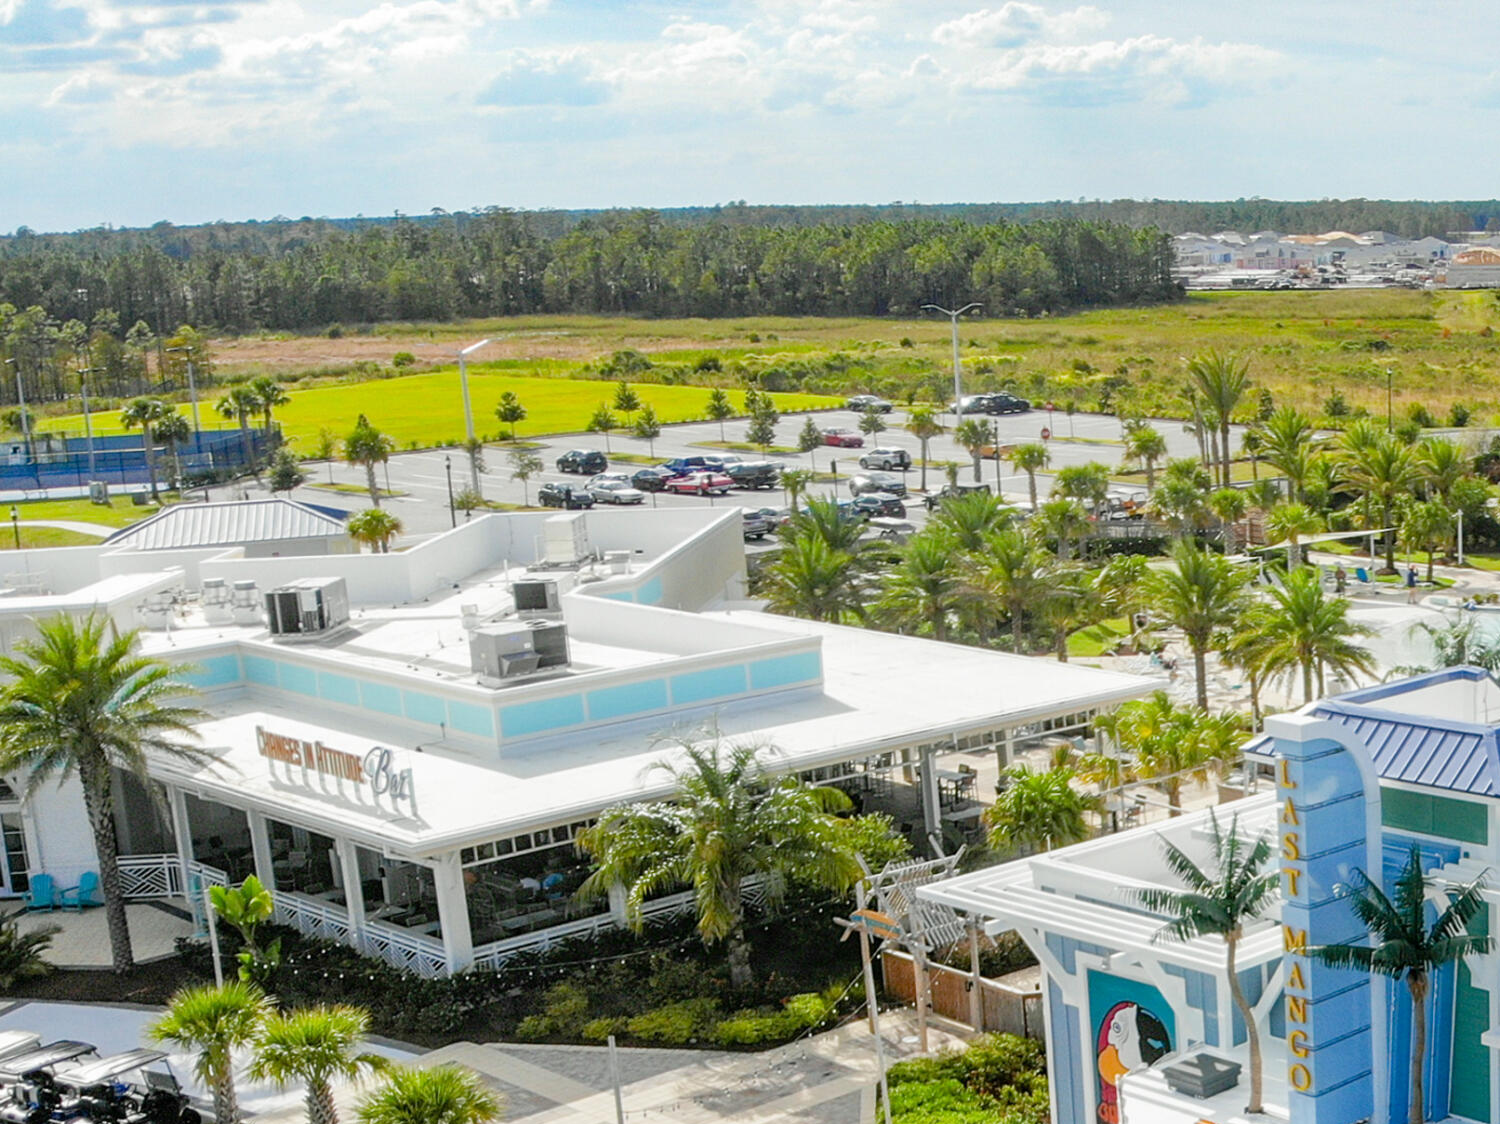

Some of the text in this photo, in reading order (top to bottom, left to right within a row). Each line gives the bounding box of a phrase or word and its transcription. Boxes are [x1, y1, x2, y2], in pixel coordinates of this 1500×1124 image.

[256, 725, 302, 767] CHANGES
[301, 740, 315, 770] IN
[315, 740, 366, 785] ATTITUDE
[1280, 759, 1302, 897] LAST
[1283, 925, 1311, 1092] MANGO
